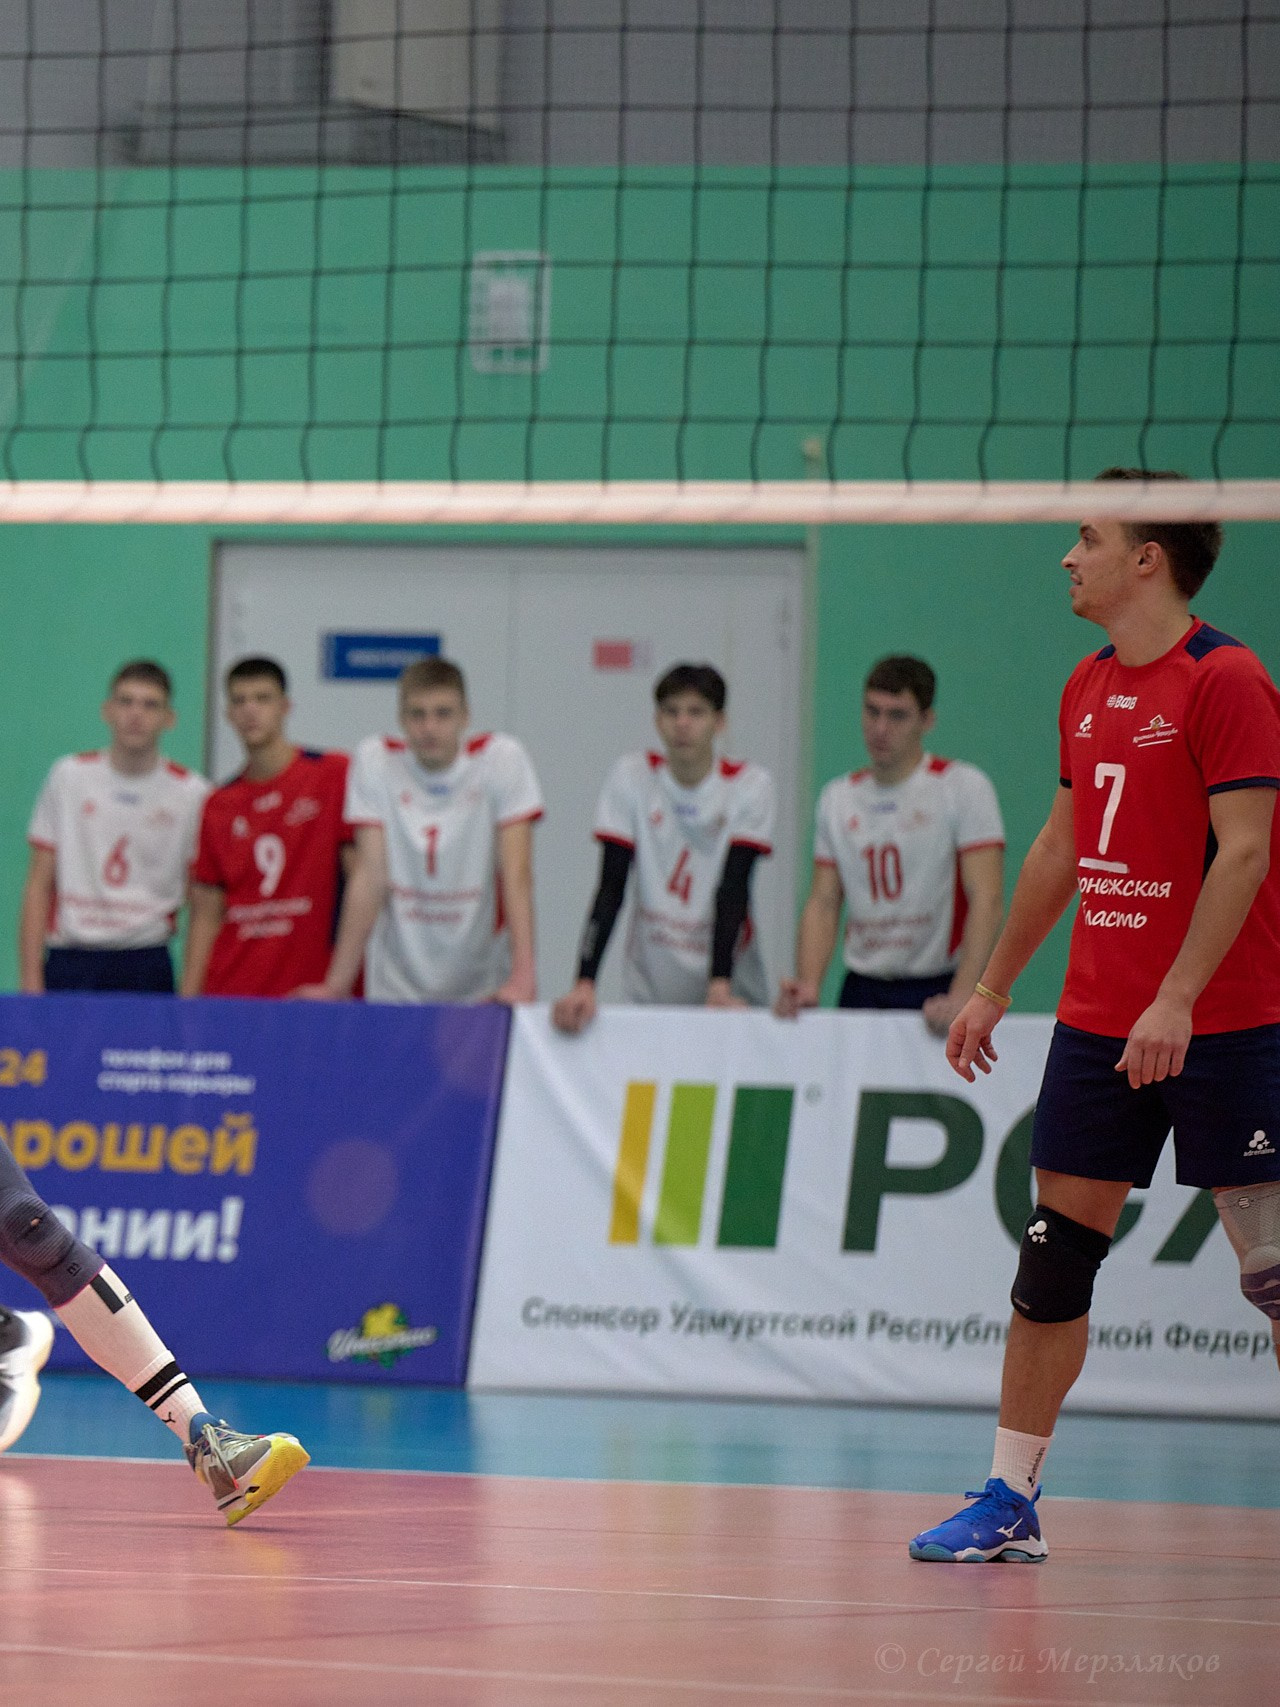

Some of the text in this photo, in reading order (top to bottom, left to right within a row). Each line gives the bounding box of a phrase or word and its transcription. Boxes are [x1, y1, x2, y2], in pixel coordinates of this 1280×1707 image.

[1094, 762, 1126, 856] 7
[102, 834, 130, 889] 6
[253, 833, 287, 897] 9
[422, 823, 439, 878] 1
[667, 847, 693, 905] 4
[862, 844, 903, 905] 10
[1077, 876, 1172, 898] онежская
[1082, 901, 1148, 929] ласть
[521, 1297, 662, 1336] Спонсор
[670, 1301, 857, 1344] Удмуртской
